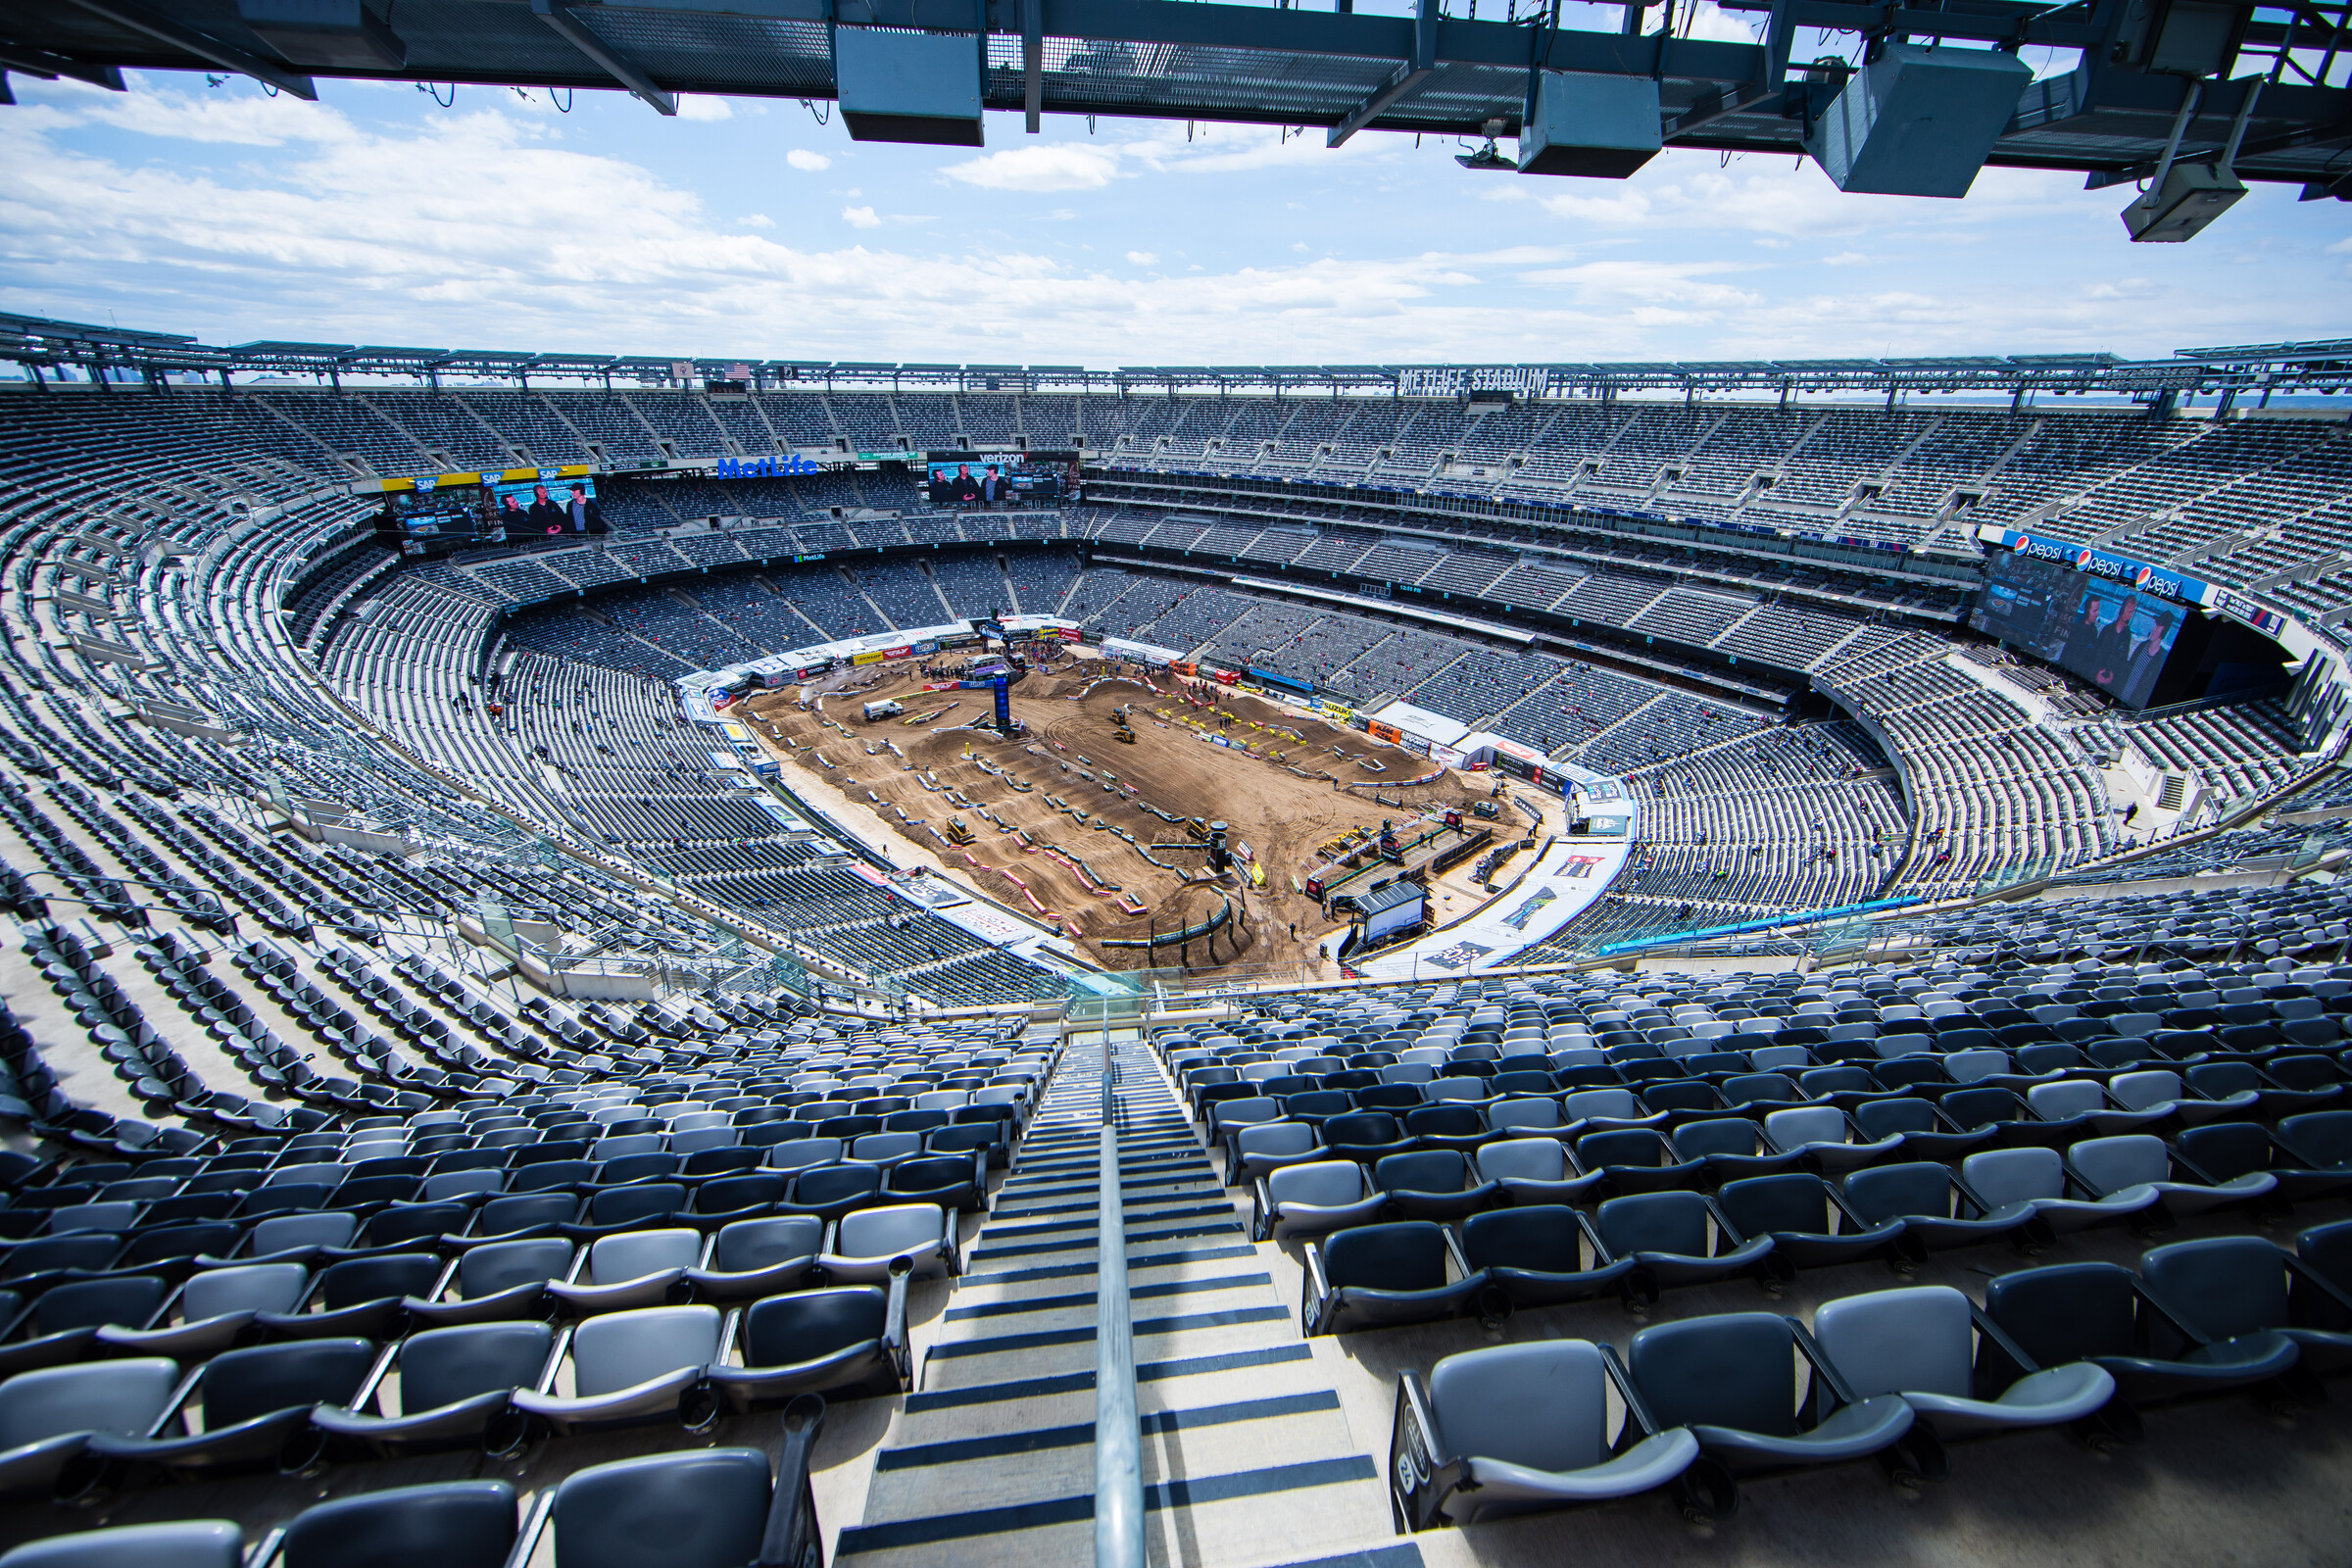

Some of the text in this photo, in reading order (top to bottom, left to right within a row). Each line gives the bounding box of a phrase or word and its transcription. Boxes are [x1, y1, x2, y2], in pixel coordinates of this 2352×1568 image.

[1398, 368, 1548, 392] METLIFE STADIUM
[979, 452, 1025, 464] verizon
[539, 469, 559, 480] SAP
[717, 454, 818, 480] MetLife
[416, 480, 436, 491] SAP
[482, 473, 502, 485] SAP
[2027, 542, 2065, 560] pepsi
[2087, 557, 2125, 576] pepsi
[2146, 573, 2182, 598] pepsi
[1324, 702, 1351, 715] SUZUKI
[1375, 724, 1395, 734] KTM
[1400, 1459, 1411, 1486] 24
